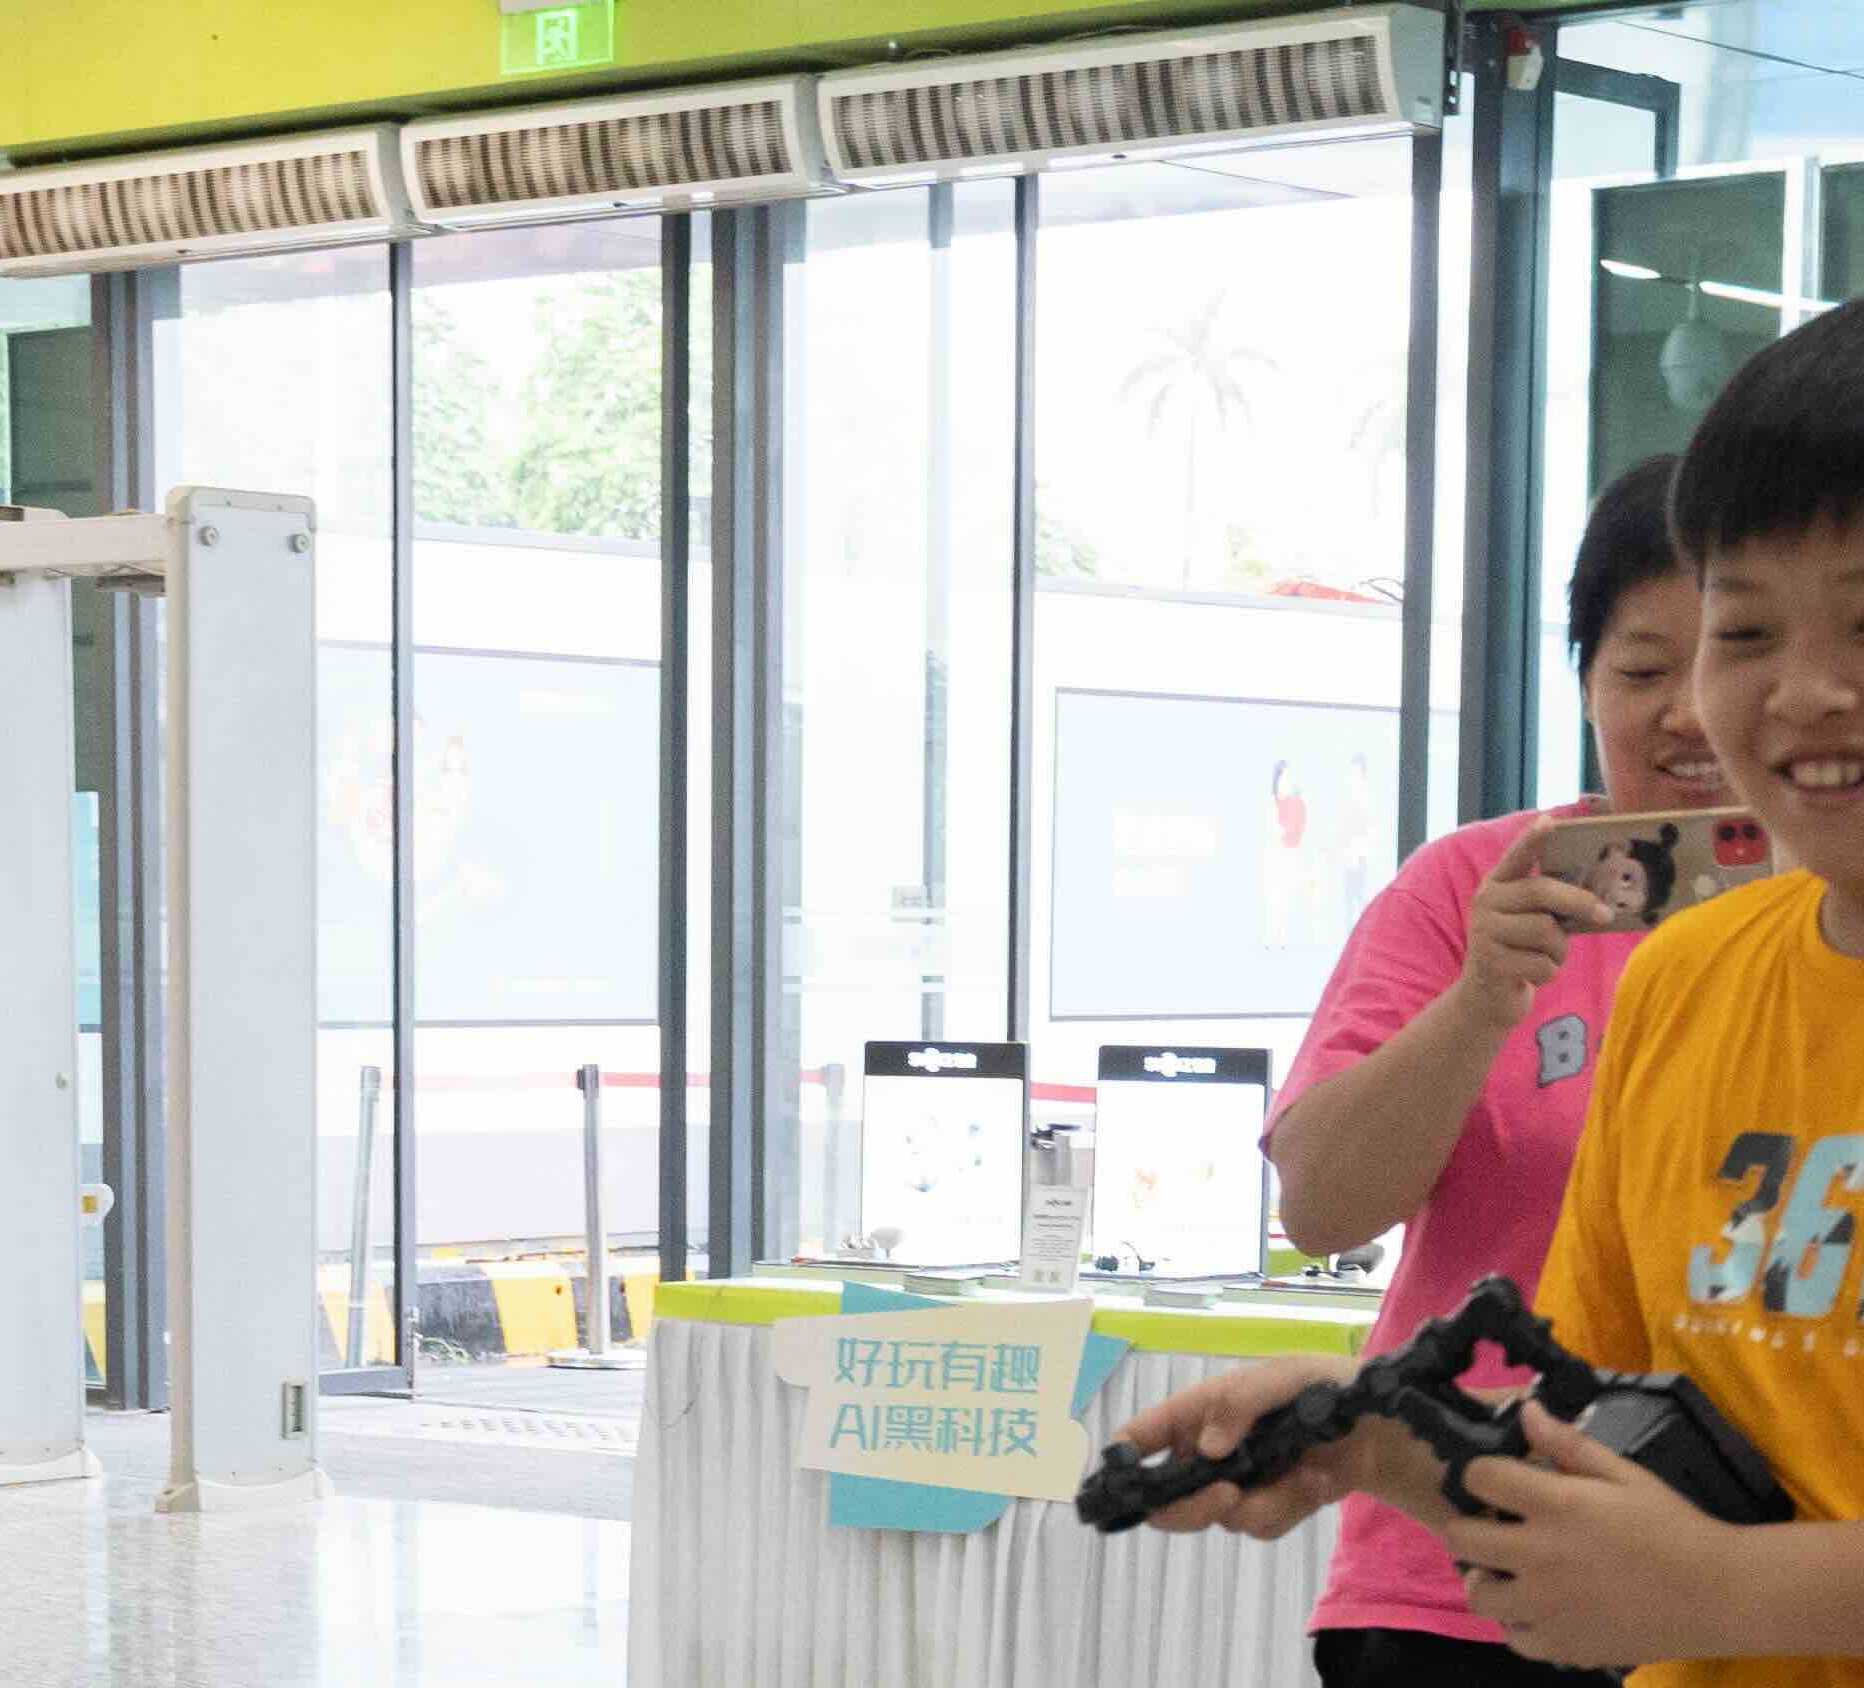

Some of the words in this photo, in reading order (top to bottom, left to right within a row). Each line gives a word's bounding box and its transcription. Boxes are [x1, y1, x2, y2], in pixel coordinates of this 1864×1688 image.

[835, 1337, 1042, 1394] 好玩有趣
[829, 1406, 1039, 1459] AI黑科技
